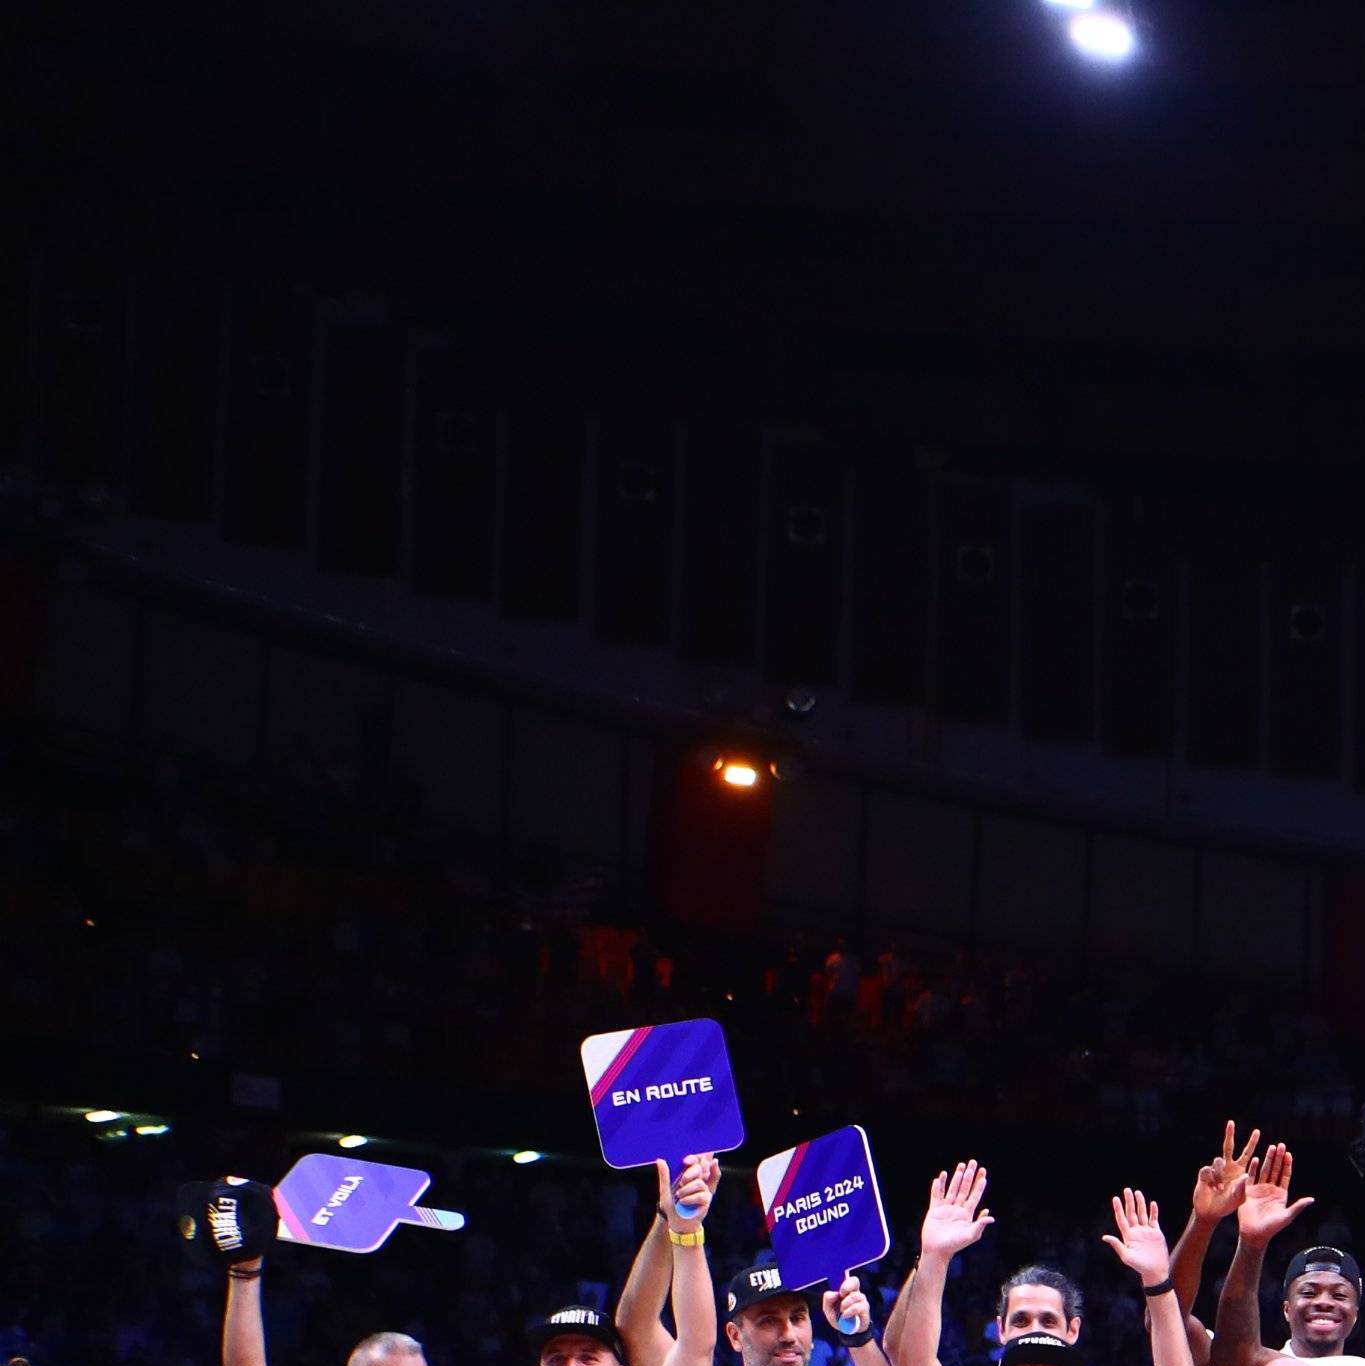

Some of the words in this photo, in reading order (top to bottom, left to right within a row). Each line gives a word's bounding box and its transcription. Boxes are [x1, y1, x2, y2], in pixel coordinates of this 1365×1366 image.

[612, 1080, 641, 1107] EN
[645, 1076, 713, 1101] ROUTE
[773, 1191, 821, 1223] PARIS
[825, 1175, 864, 1201] 2024
[311, 1206, 334, 1227] ET
[795, 1202, 850, 1235] BOUND
